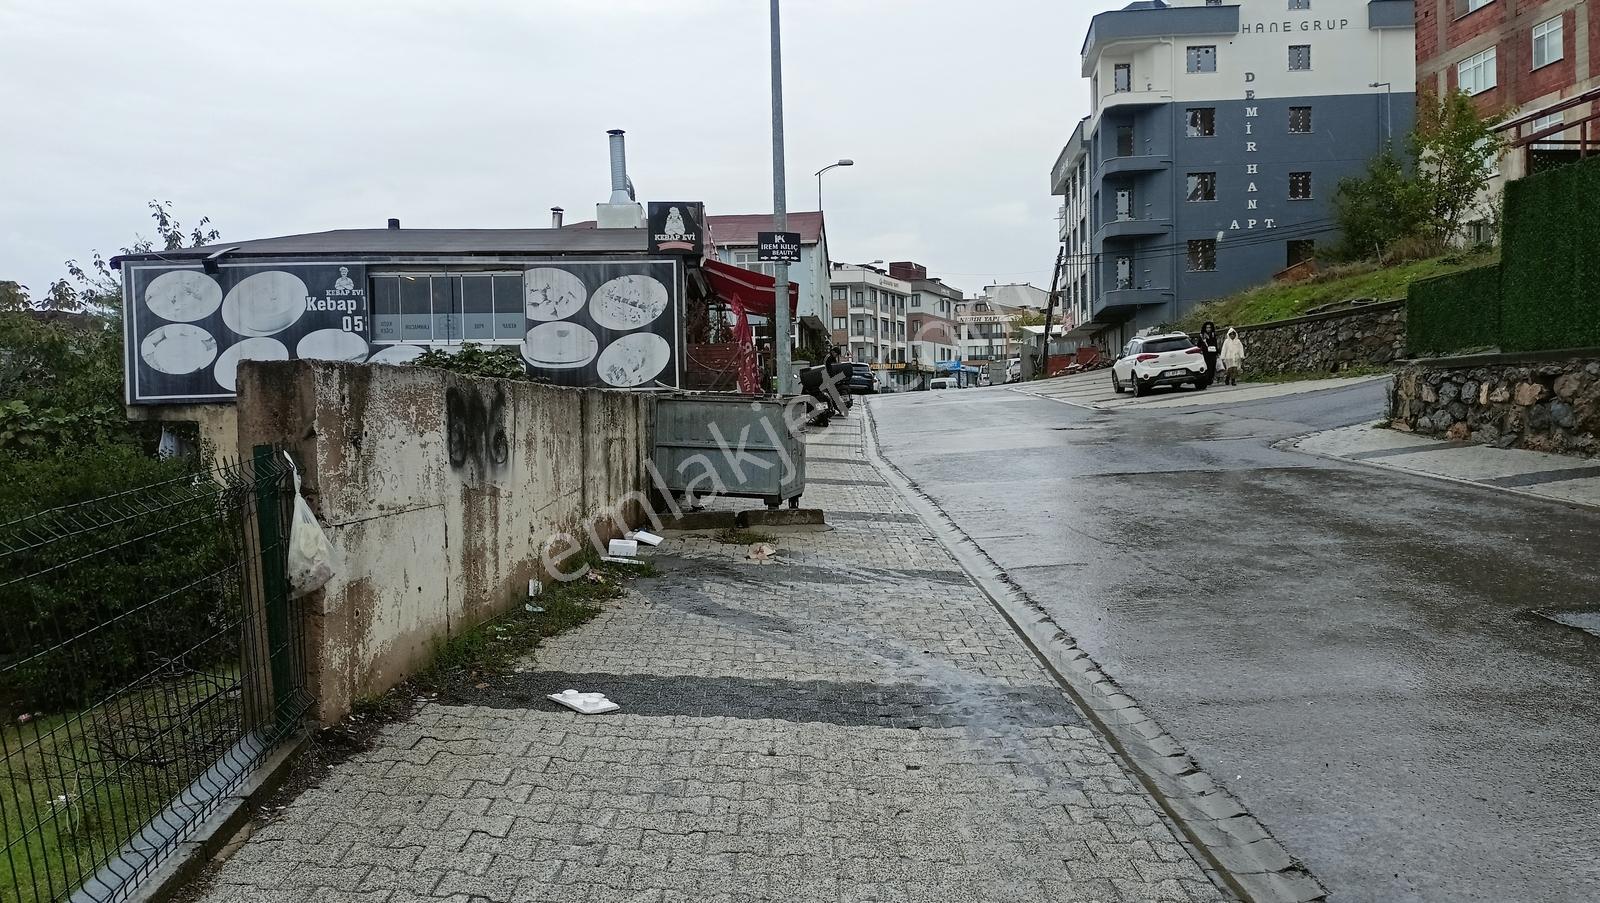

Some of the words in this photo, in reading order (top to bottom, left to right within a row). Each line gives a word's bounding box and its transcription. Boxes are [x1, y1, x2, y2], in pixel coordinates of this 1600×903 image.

[1241, 22, 1292, 34] HANE
[1299, 19, 1349, 32] GRUP
[682, 232, 696, 241] EVİ
[306, 296, 357, 314] Kebap
[342, 315, 368, 332] 05
